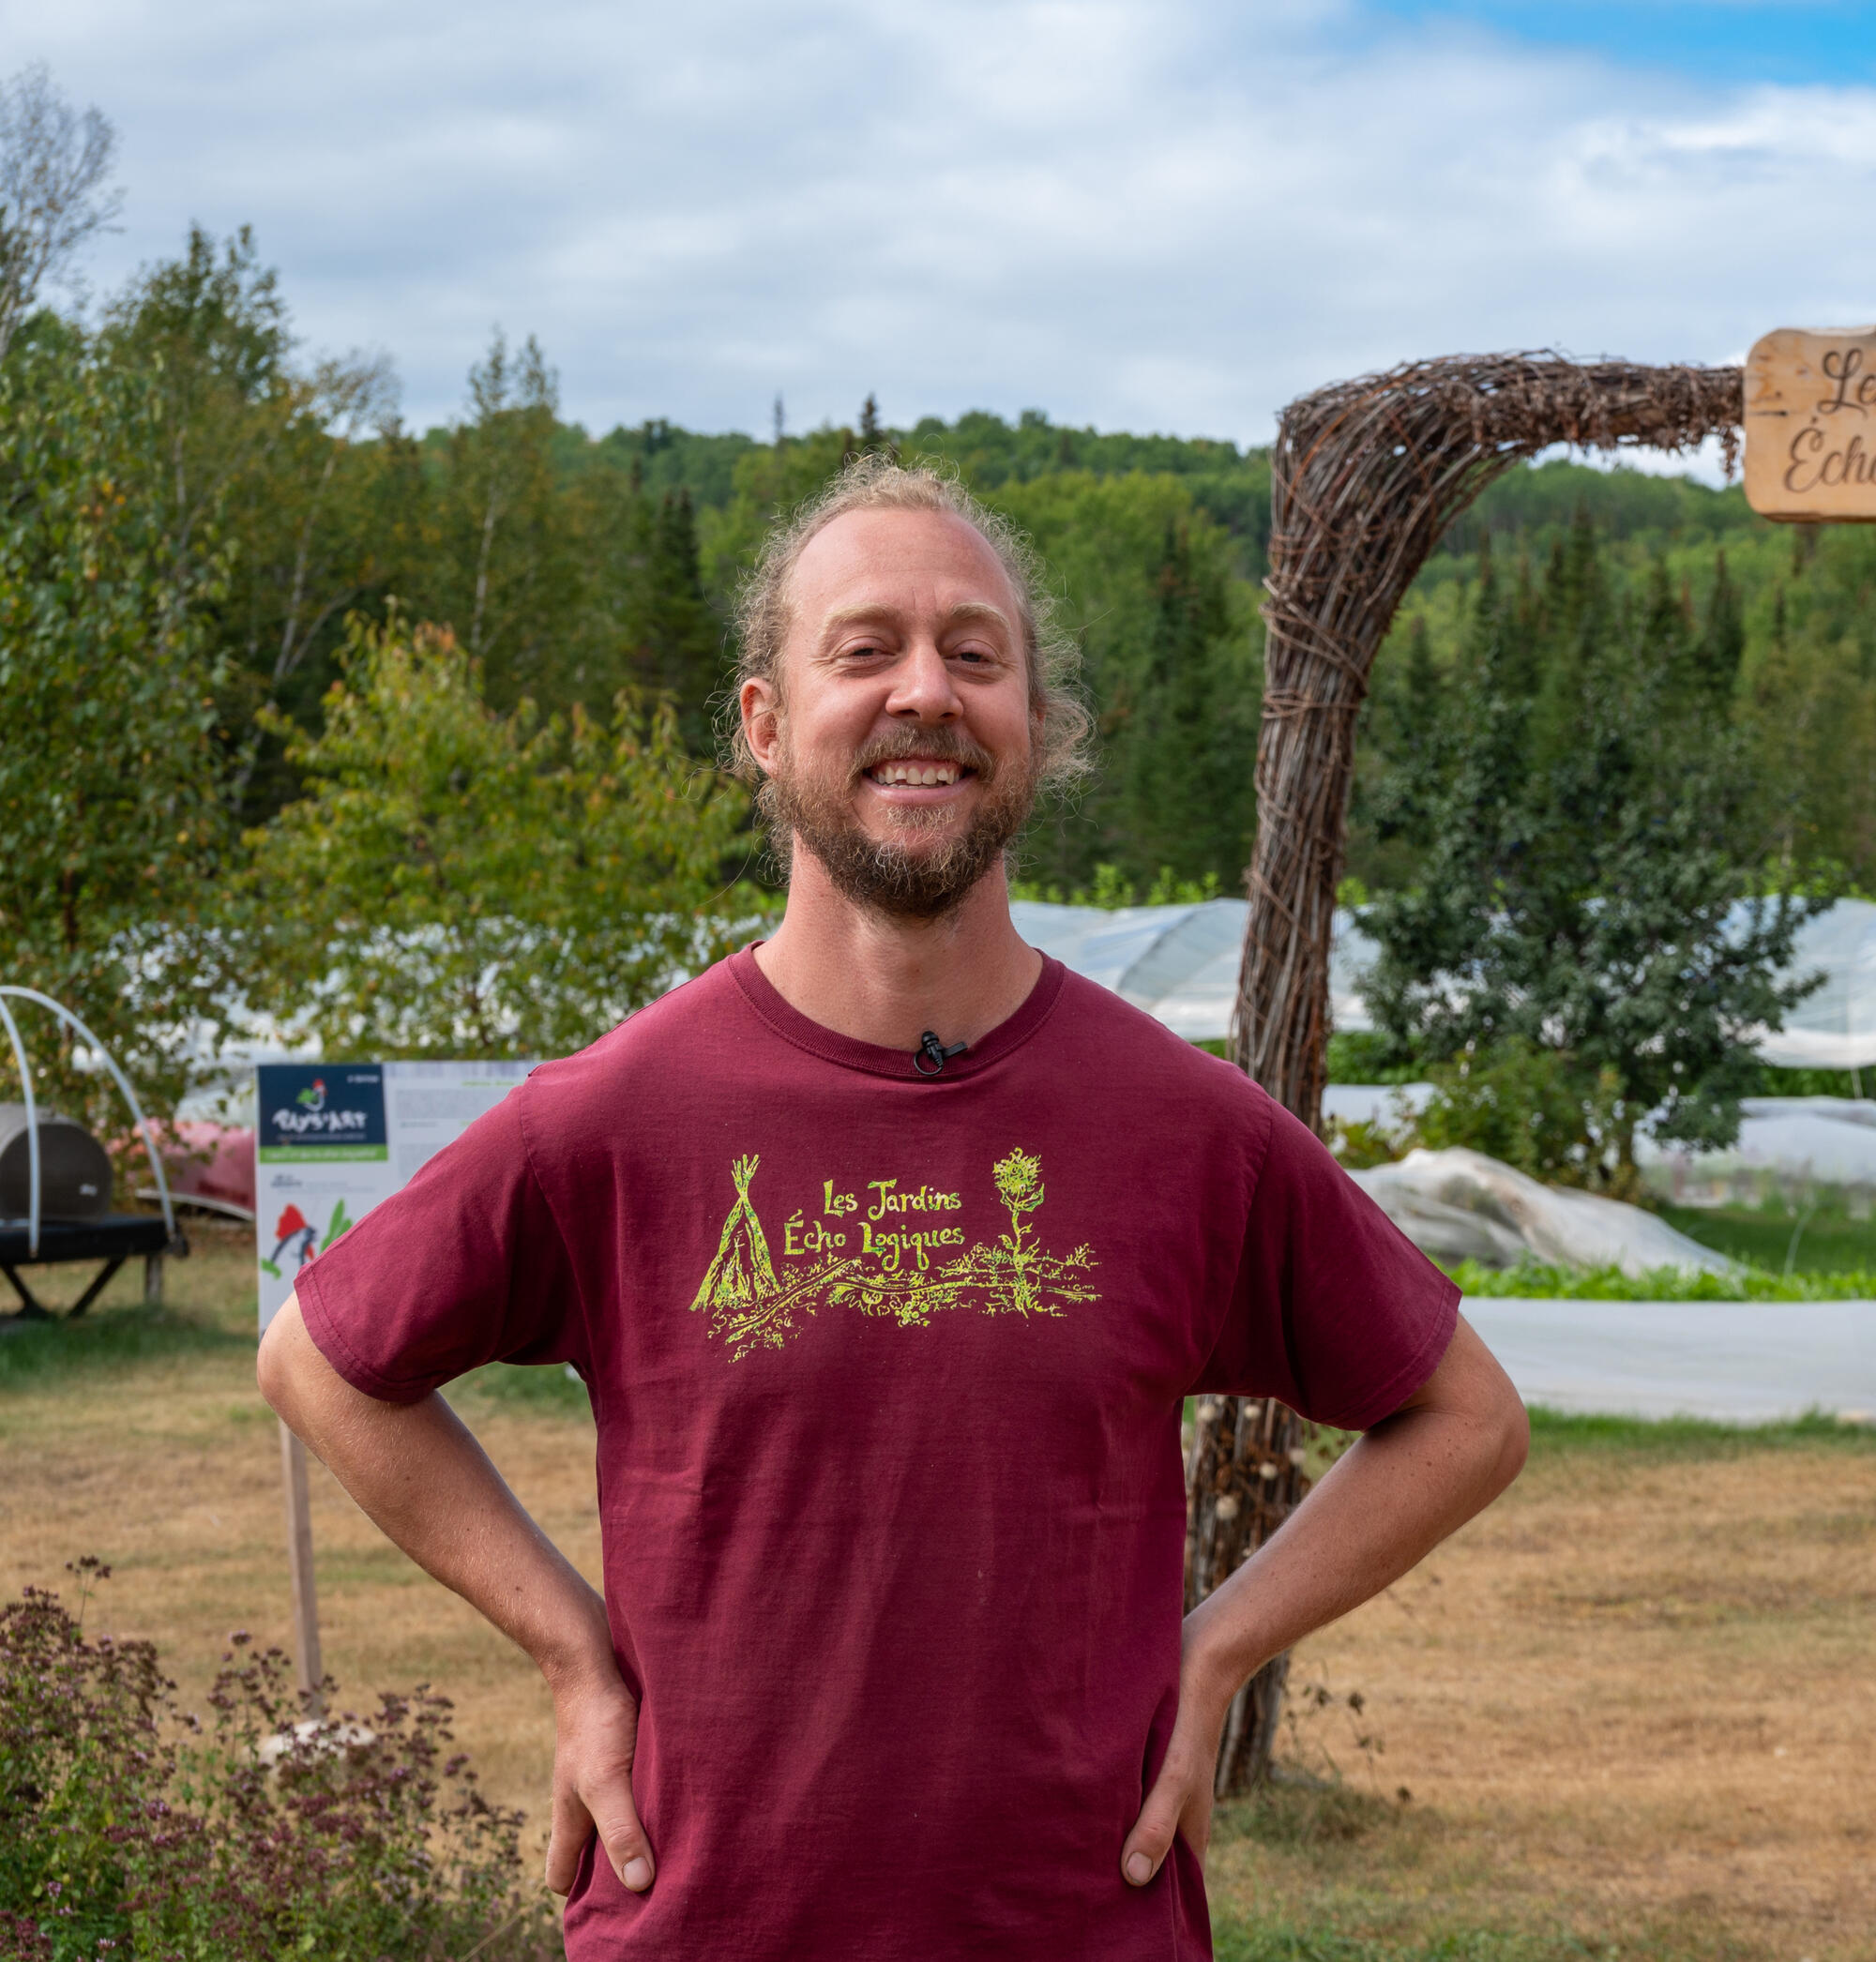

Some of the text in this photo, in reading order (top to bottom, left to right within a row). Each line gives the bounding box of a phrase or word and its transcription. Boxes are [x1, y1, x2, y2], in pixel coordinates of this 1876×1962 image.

[823, 1178, 962, 1220] Les Jardins
[783, 1208, 965, 1271] Écho Logiques
